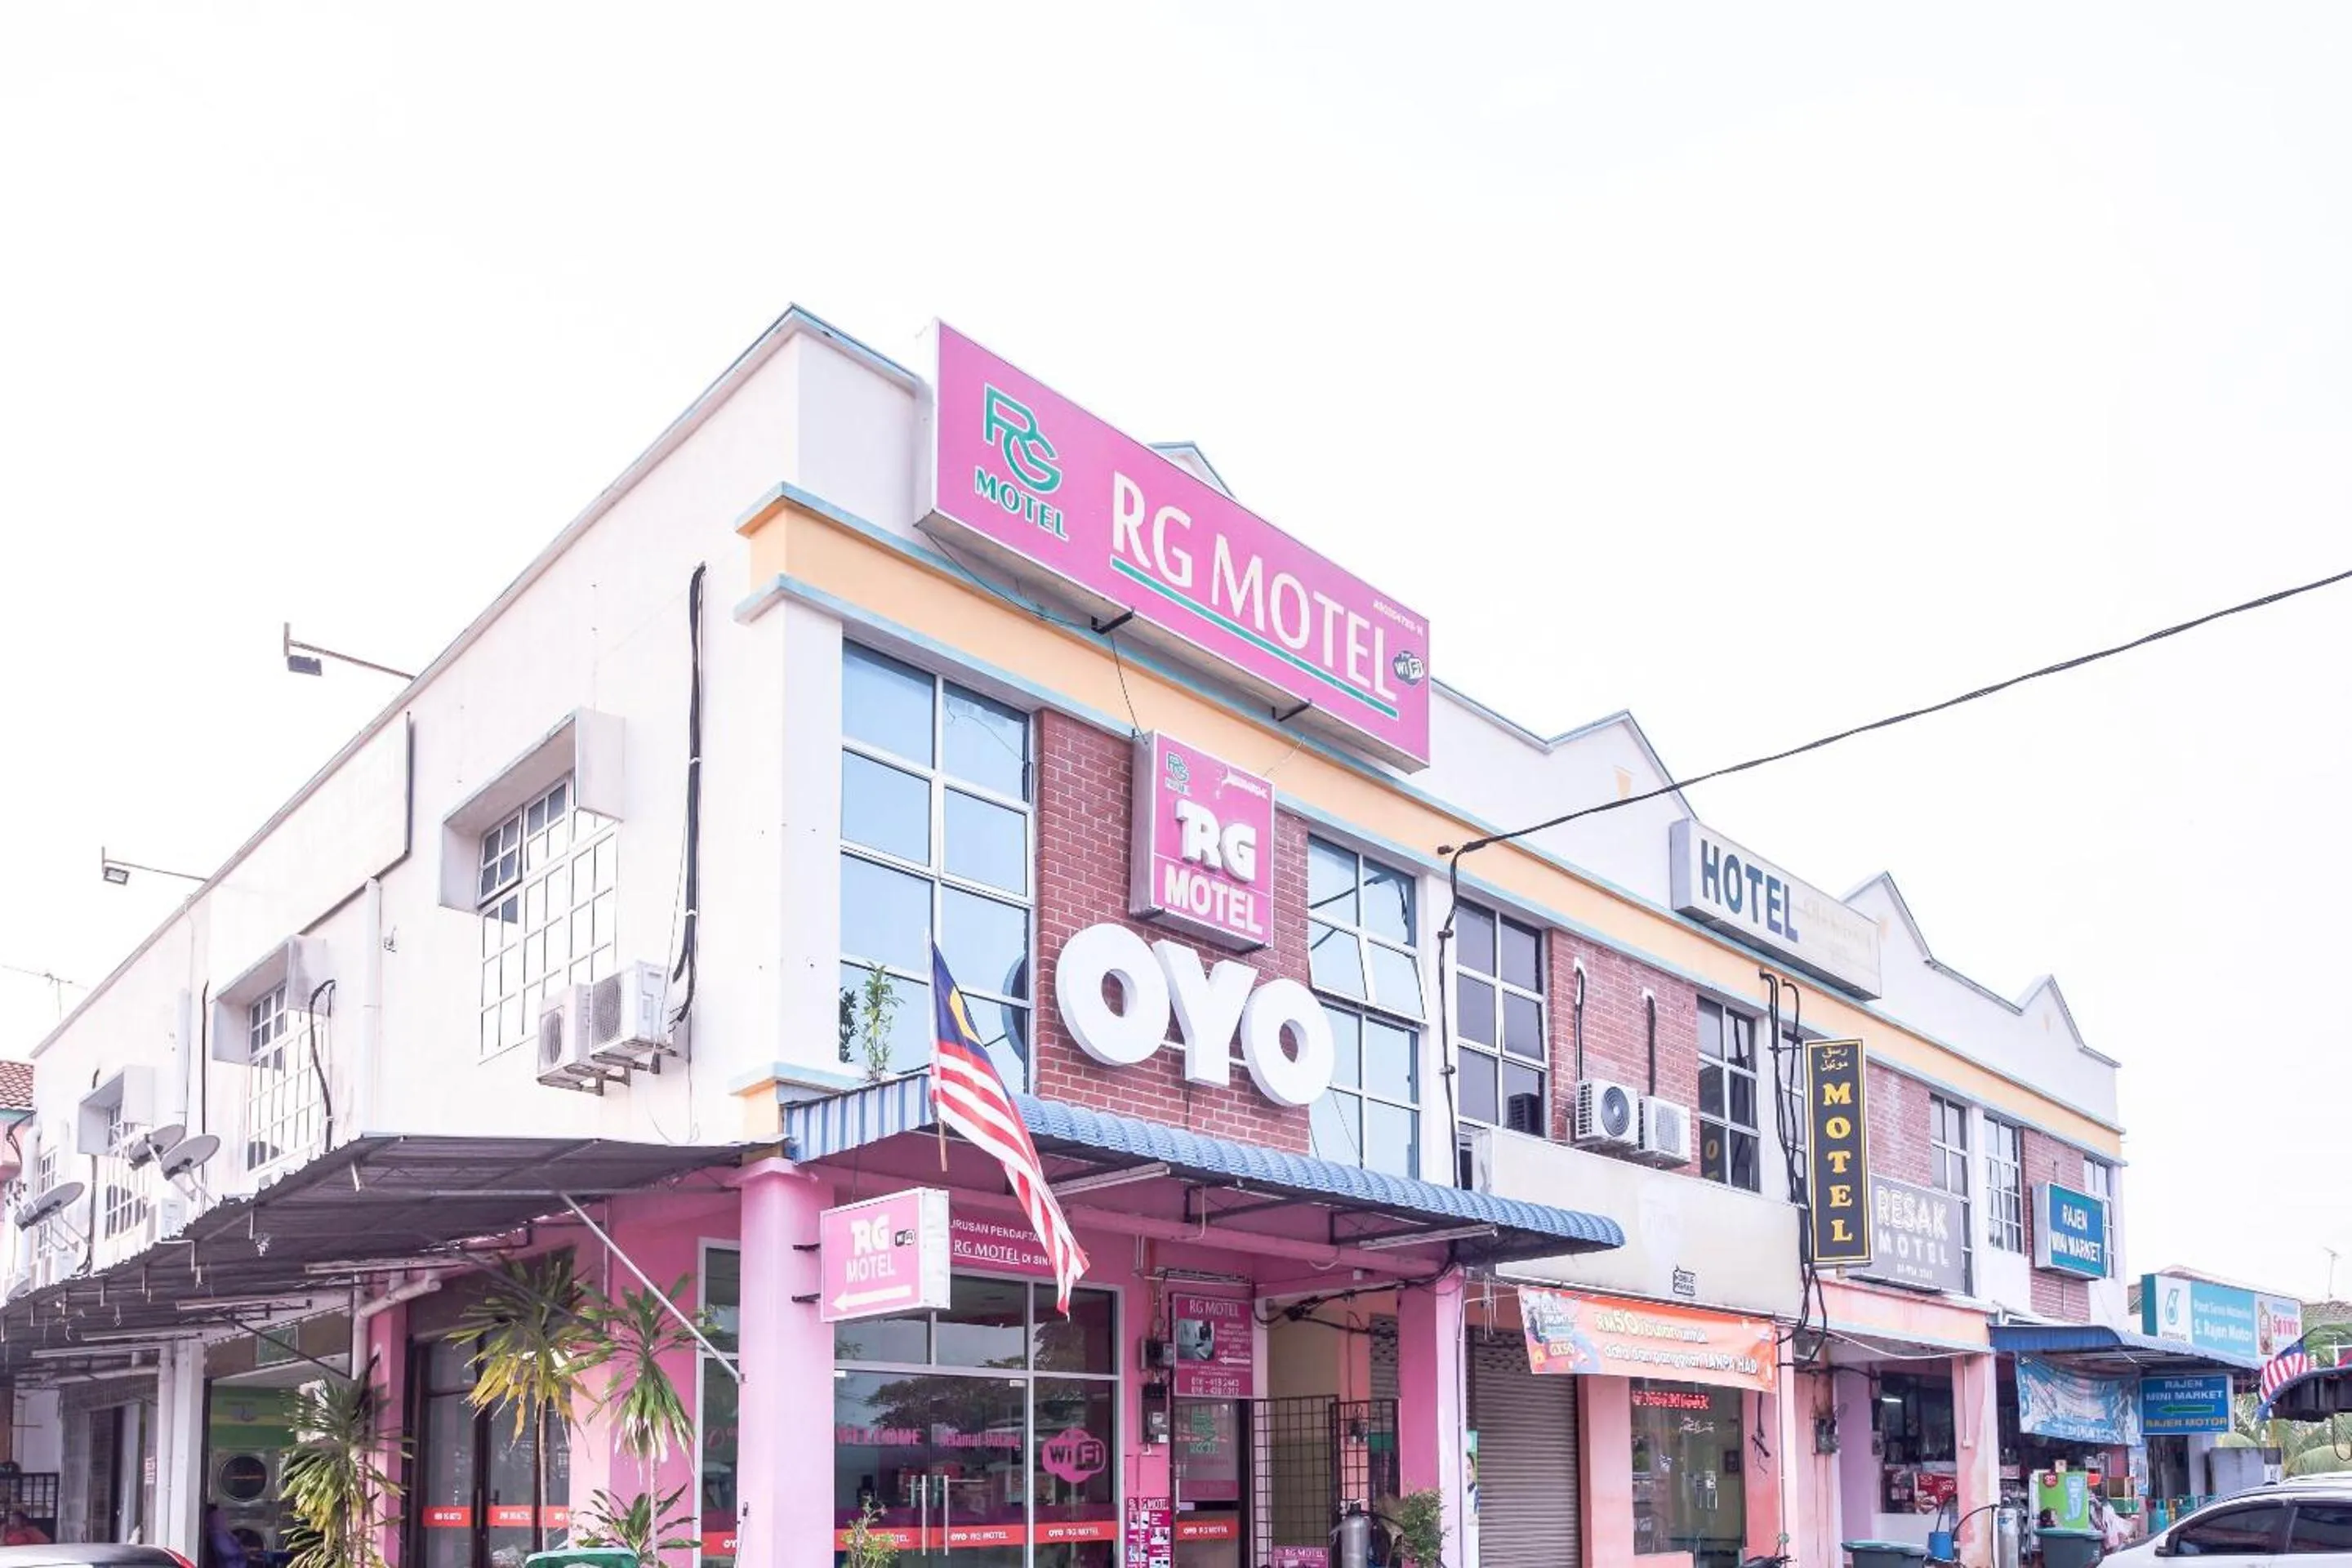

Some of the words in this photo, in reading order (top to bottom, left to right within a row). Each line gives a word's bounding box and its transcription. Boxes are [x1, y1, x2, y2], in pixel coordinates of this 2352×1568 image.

[983, 382, 1062, 495] RG
[974, 466, 1069, 542] MOTEL
[1112, 470, 1192, 589] RG
[1211, 532, 1397, 702] MOTEL
[1176, 798, 1256, 882] RG
[1165, 863, 1263, 933] MOTEL
[1700, 839, 1798, 942] HOTEL
[1056, 923, 1334, 1107] OYO
[1822, 1081, 1853, 1242] MOTEL
[2061, 1203, 2088, 1232] RAJEN
[850, 1214, 889, 1256] RG
[991, 1226, 1040, 1242] PENDAFTA
[1878, 1228, 1950, 1267] MOTEL
[2068, 1235, 2101, 1263] MARKET
[954, 1240, 972, 1254] RG
[975, 1243, 1018, 1262] MOTEL
[846, 1253, 896, 1283] MOTEL
[1205, 1301, 1239, 1317] MOTEL
[2145, 1392, 2172, 1401] MINI
[2174, 1390, 2224, 1401] MARKET
[2165, 1379, 2203, 1389] RAJEN
[2185, 1416, 2227, 1428] MOTOR
[1049, 1444, 1100, 1464] WiFi
[951, 1532, 967, 1541] OYO
[982, 1531, 1010, 1540] MOTEL
